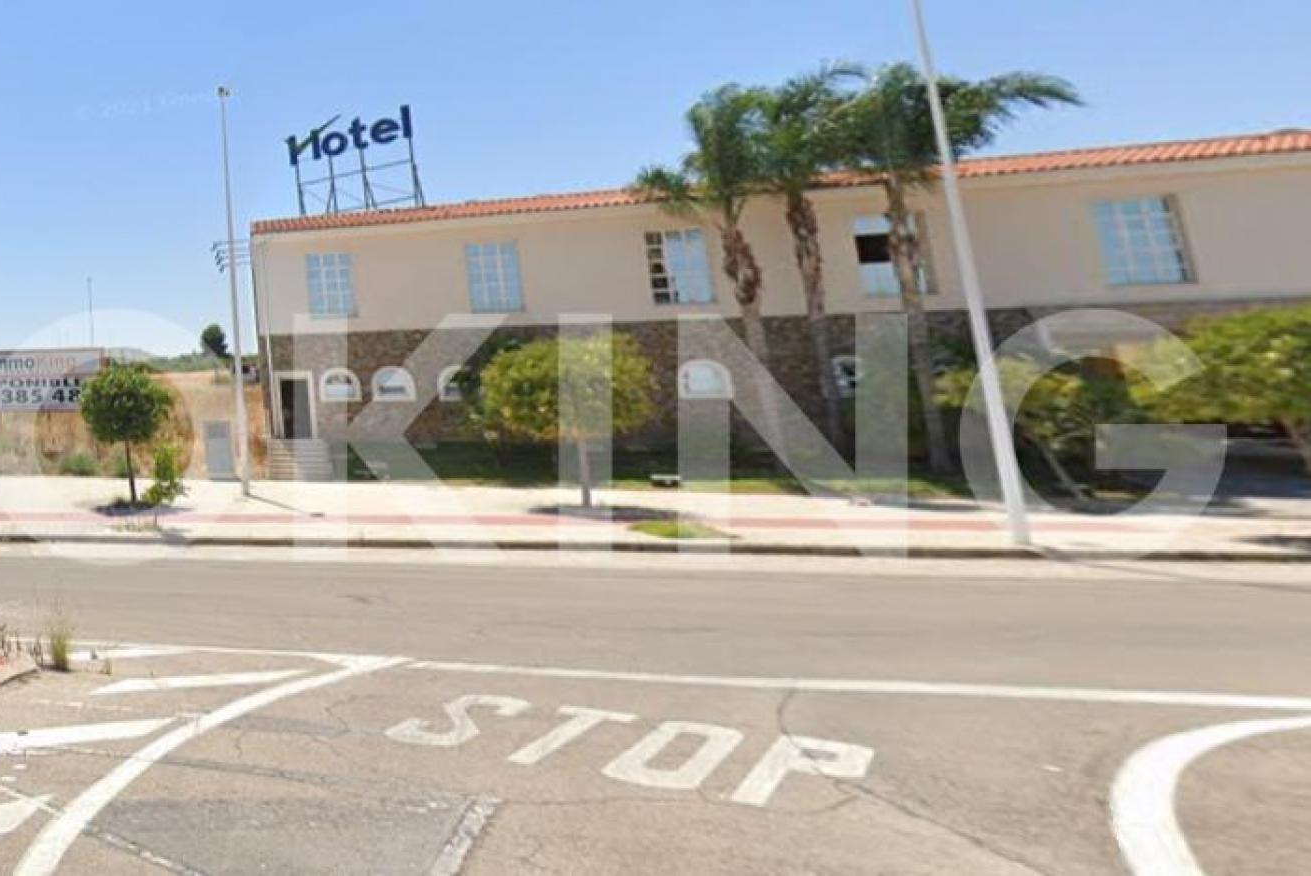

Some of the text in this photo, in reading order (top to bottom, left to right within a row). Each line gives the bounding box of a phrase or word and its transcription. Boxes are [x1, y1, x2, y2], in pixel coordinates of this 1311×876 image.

[284, 104, 411, 165] Hotel
[1, 388, 42, 404] 385
[384, 694, 875, 807] STOP
